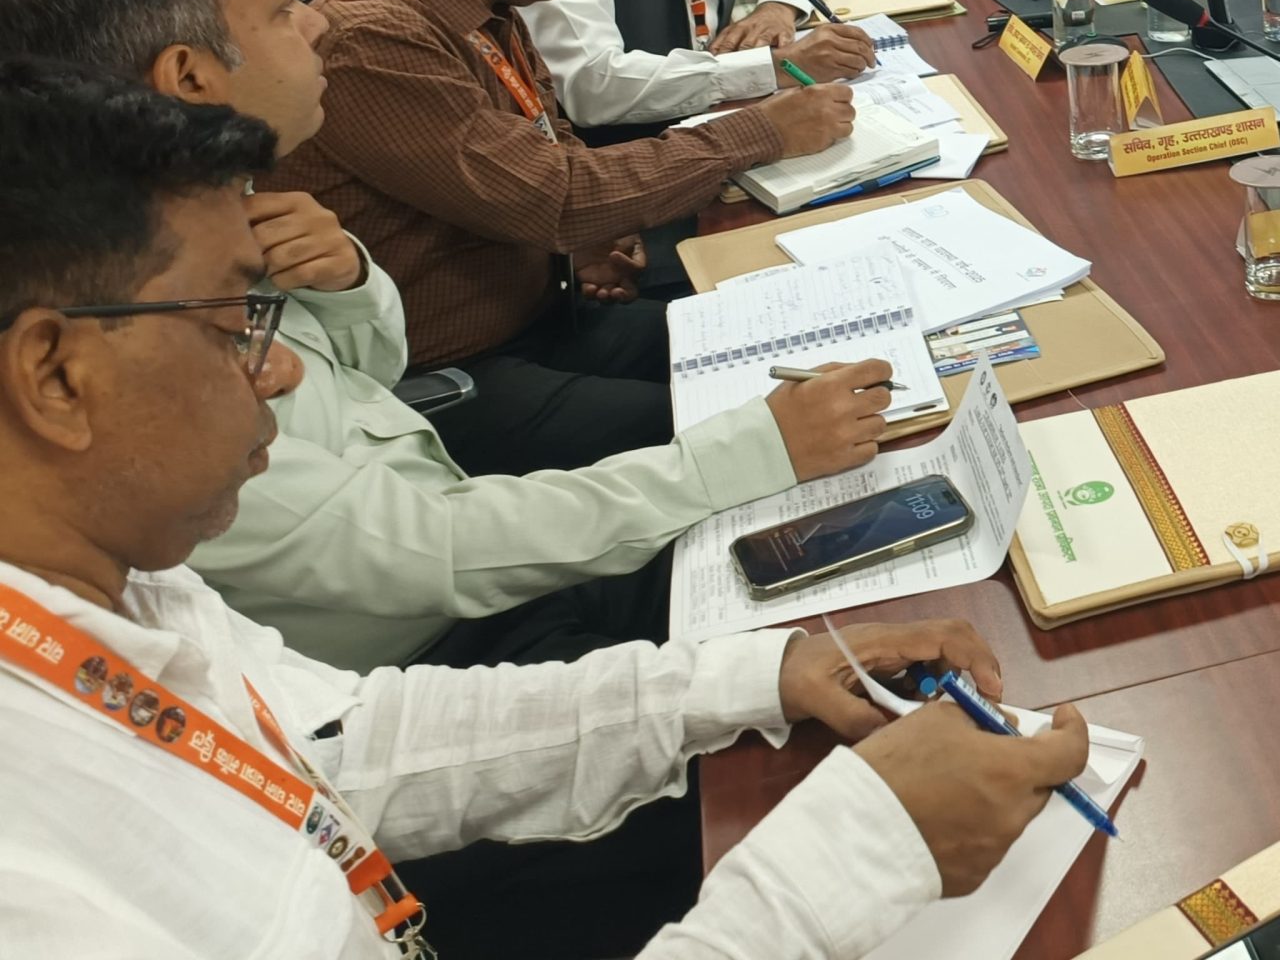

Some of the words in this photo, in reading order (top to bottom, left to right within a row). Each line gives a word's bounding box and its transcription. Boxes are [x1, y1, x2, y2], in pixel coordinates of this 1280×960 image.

[1122, 138, 1156, 154] सचिव,
[1158, 134, 1179, 151] गृह,
[1182, 124, 1233, 143] उत्तराखण्ड
[1236, 117, 1265, 133] शासन
[1146, 150, 1181, 163] Operation
[1182, 145, 1207, 155] Section
[1209, 141, 1227, 150] Chief
[905, 492, 935, 520] 11:09
[5, 615, 43, 650] धाम
[35, 634, 68, 665] चार
[184, 725, 222, 764] ड्रिल
[210, 747, 243, 778] मॉक
[237, 762, 268, 790] यात्रा
[261, 779, 290, 805] धाम
[283, 792, 309, 817] चार
